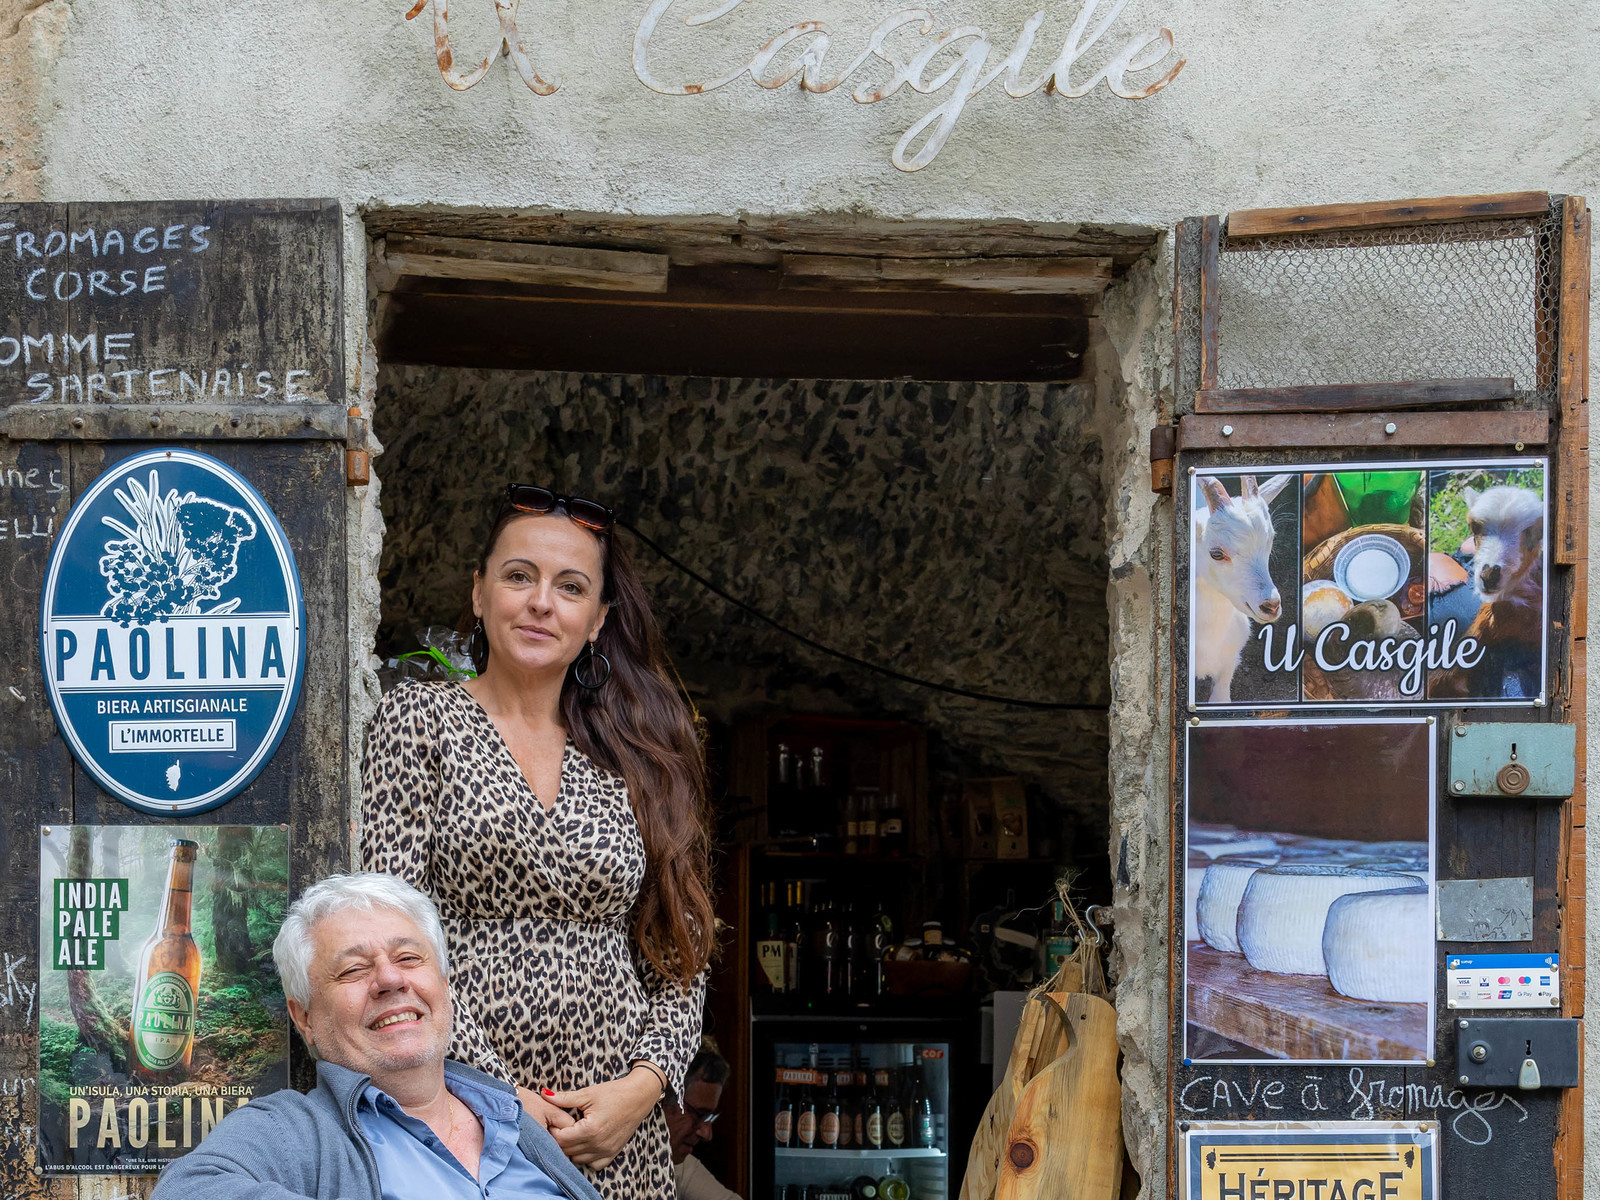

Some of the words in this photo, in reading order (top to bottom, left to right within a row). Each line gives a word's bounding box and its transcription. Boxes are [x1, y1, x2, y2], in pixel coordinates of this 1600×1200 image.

[631, 0, 1187, 172] Casgile
[0, 222, 212, 259] FROMAGES
[26, 265, 167, 301] CORSE
[55, 625, 287, 682] PAOLINA
[1258, 622, 1304, 673] U
[1315, 618, 1487, 696] Casgile
[97, 699, 140, 715] BIERA
[143, 697, 248, 714] ARTISGIANALE
[121, 727, 225, 744] L'IMMORTELLE
[58, 881, 122, 909] INDIA
[58, 910, 112, 938] PALE
[58, 938, 97, 966] ALE
[138, 1011, 191, 1031] PAOLINA
[125, 1086, 149, 1096] UNA
[151, 1085, 192, 1098] STORIA,
[194, 1085, 217, 1096] UNA
[69, 1097, 250, 1149] PAOLIN
